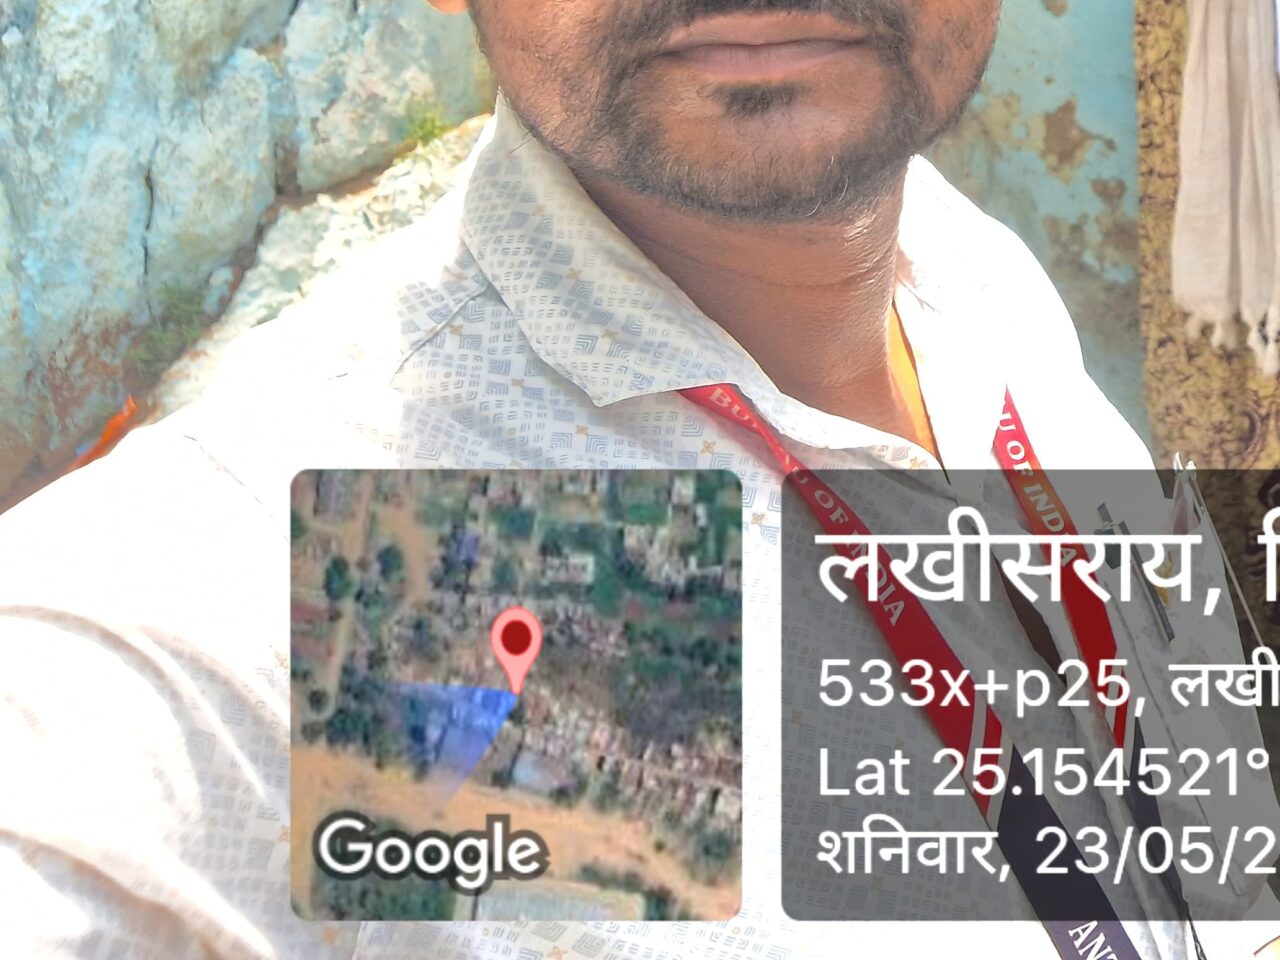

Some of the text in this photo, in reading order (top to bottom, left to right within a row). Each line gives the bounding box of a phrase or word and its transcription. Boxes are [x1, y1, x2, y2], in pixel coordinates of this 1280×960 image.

[814, 488, 851, 526] OF
[1006, 440, 1034, 477] OF
[1023, 483, 1079, 568] INDA
